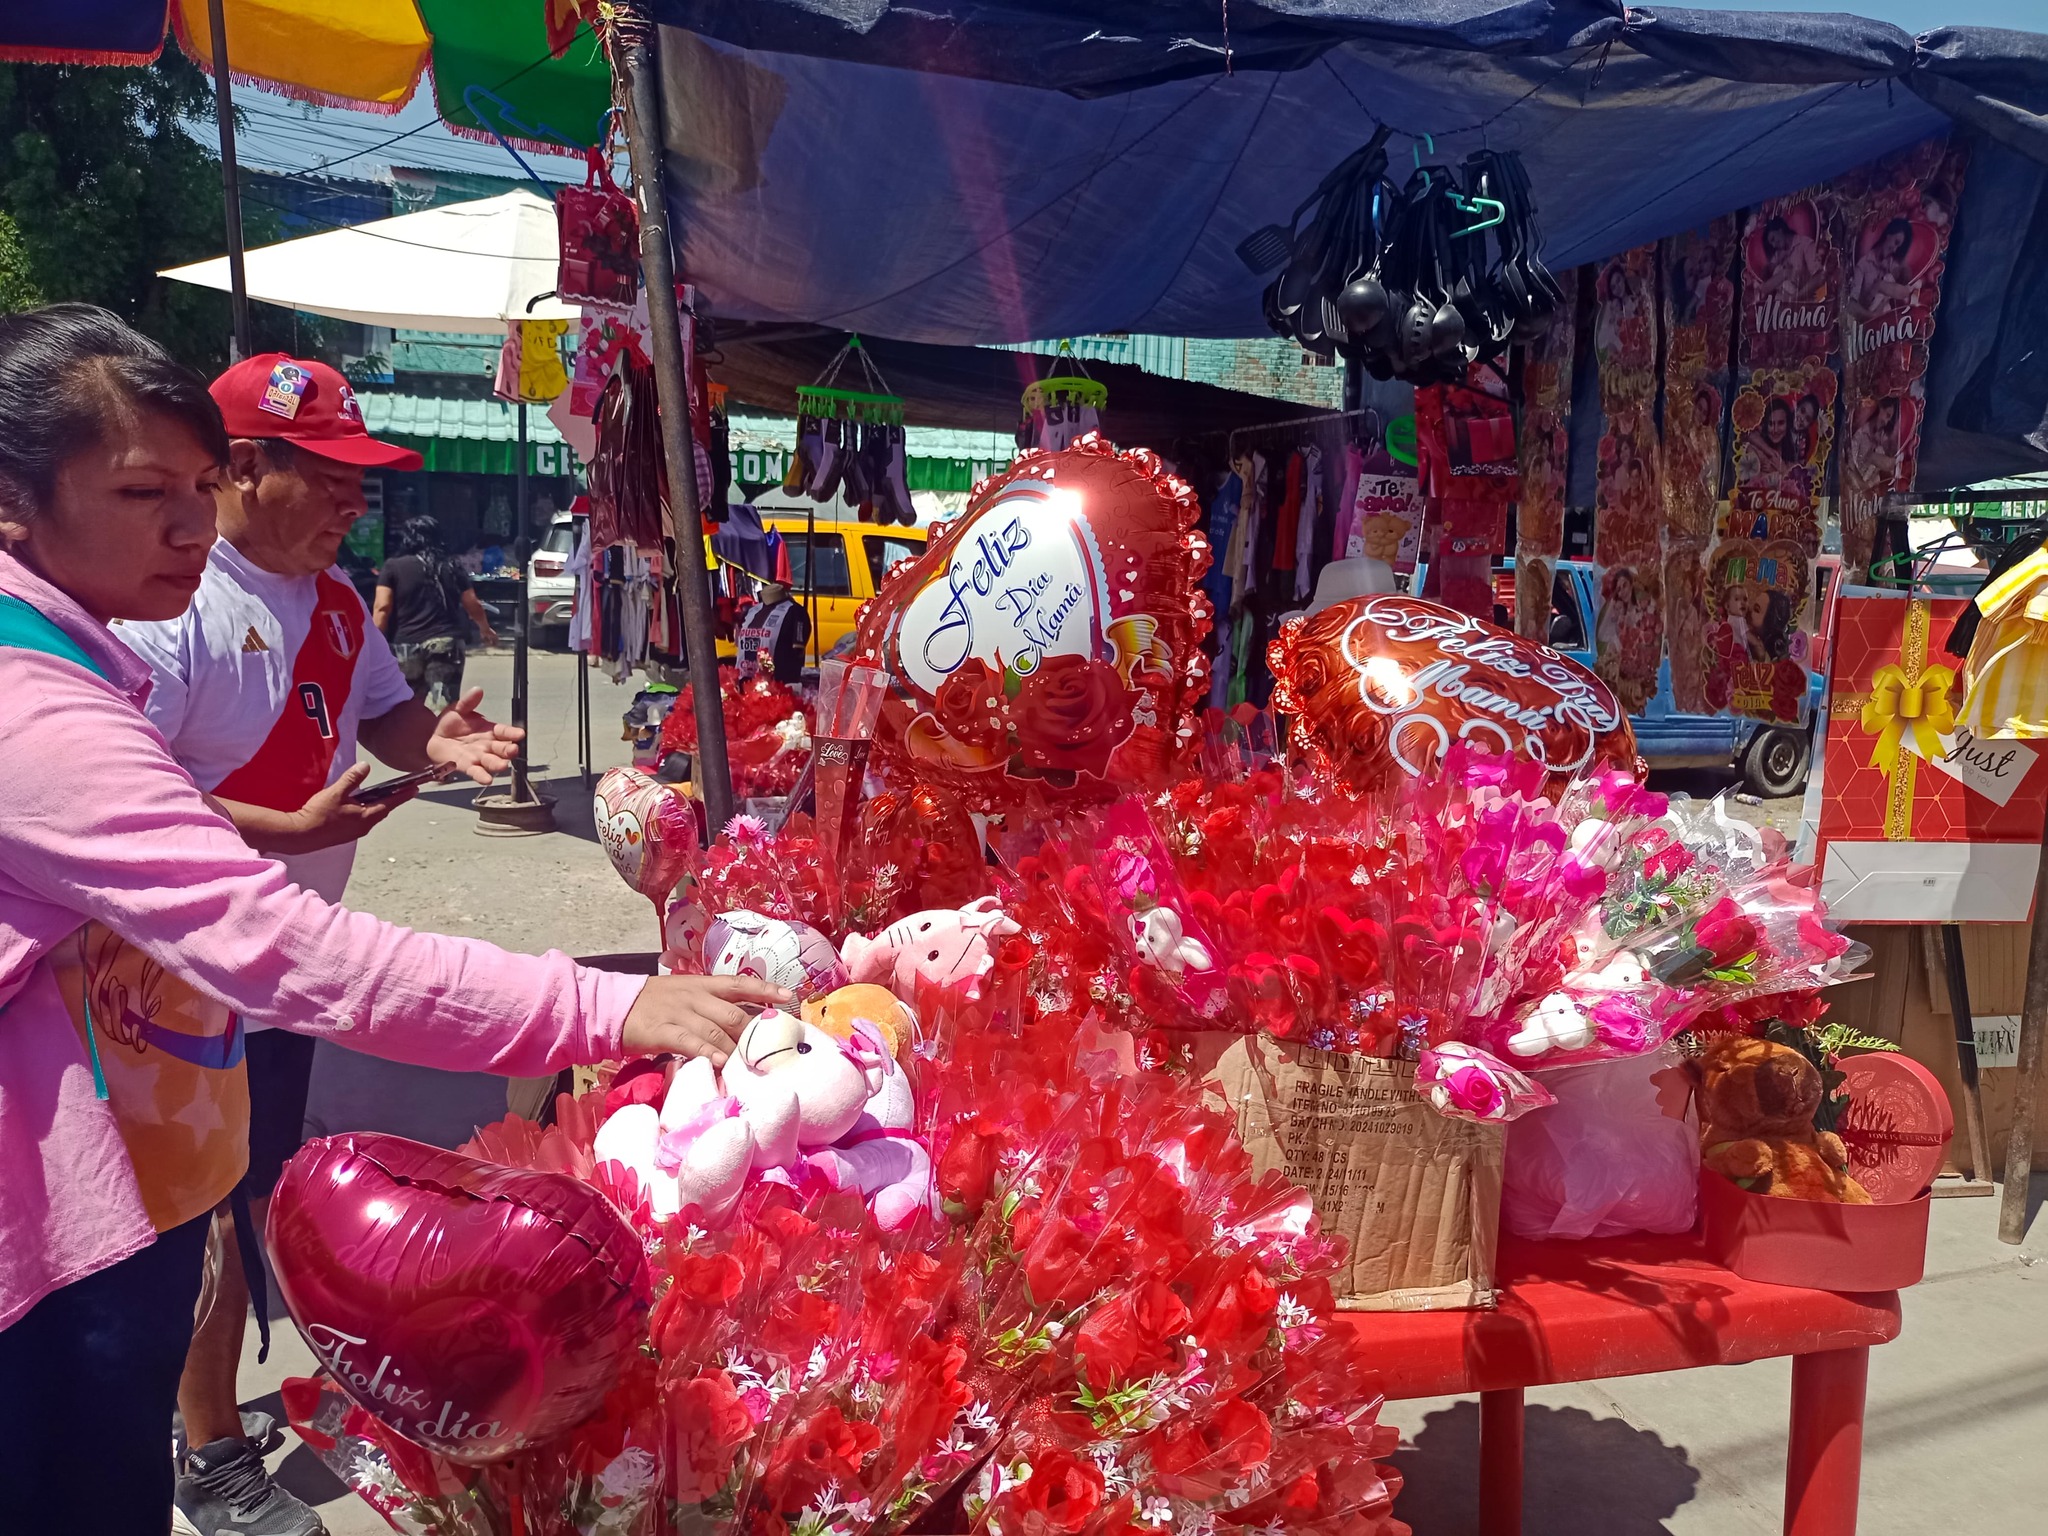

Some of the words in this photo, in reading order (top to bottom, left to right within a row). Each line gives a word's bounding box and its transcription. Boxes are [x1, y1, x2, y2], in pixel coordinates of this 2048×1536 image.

[536, 445, 578, 476] CE
[1375, 479, 1400, 497] Te
[740, 639, 760, 651] tota
[298, 682, 334, 739] 9
[821, 742, 848, 765] Love
[1943, 729, 2017, 778] Just
[1295, 1080, 1344, 1098] FRAGILE
[1292, 1097, 1318, 1112] ITEM
[1290, 1115, 1327, 1131] BATCH
[1285, 1149, 1309, 1162] QTY:
[1312, 1152, 1324, 1163] 48
[1331, 1152, 1347, 1164] CS
[1283, 1165, 1314, 1179] DATE:
[1316, 1169, 1367, 1181] 224/11/11
[308, 1323, 431, 1411] Feliz
[416, 1401, 509, 1440] día
